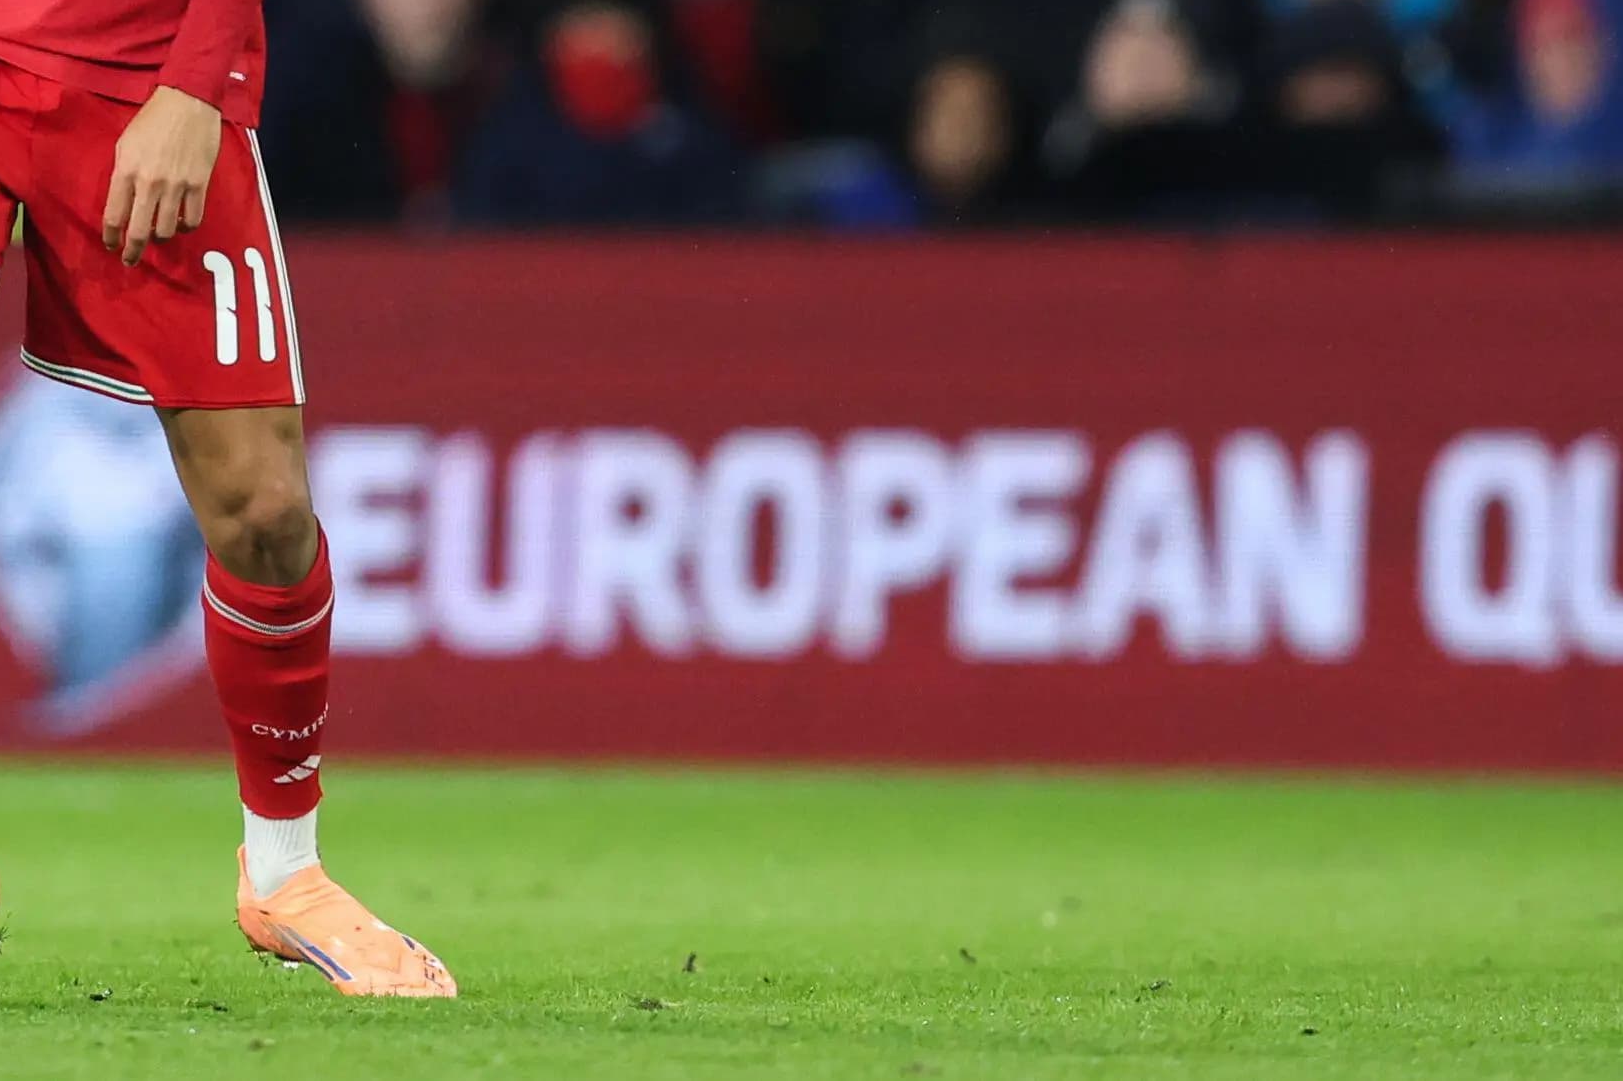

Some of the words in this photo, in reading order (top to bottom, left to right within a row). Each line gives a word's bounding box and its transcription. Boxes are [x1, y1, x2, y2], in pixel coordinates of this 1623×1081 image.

[202, 246, 276, 366] 11
[307, 426, 1368, 661] EUROPEAN
[251, 702, 329, 741] CYMR
